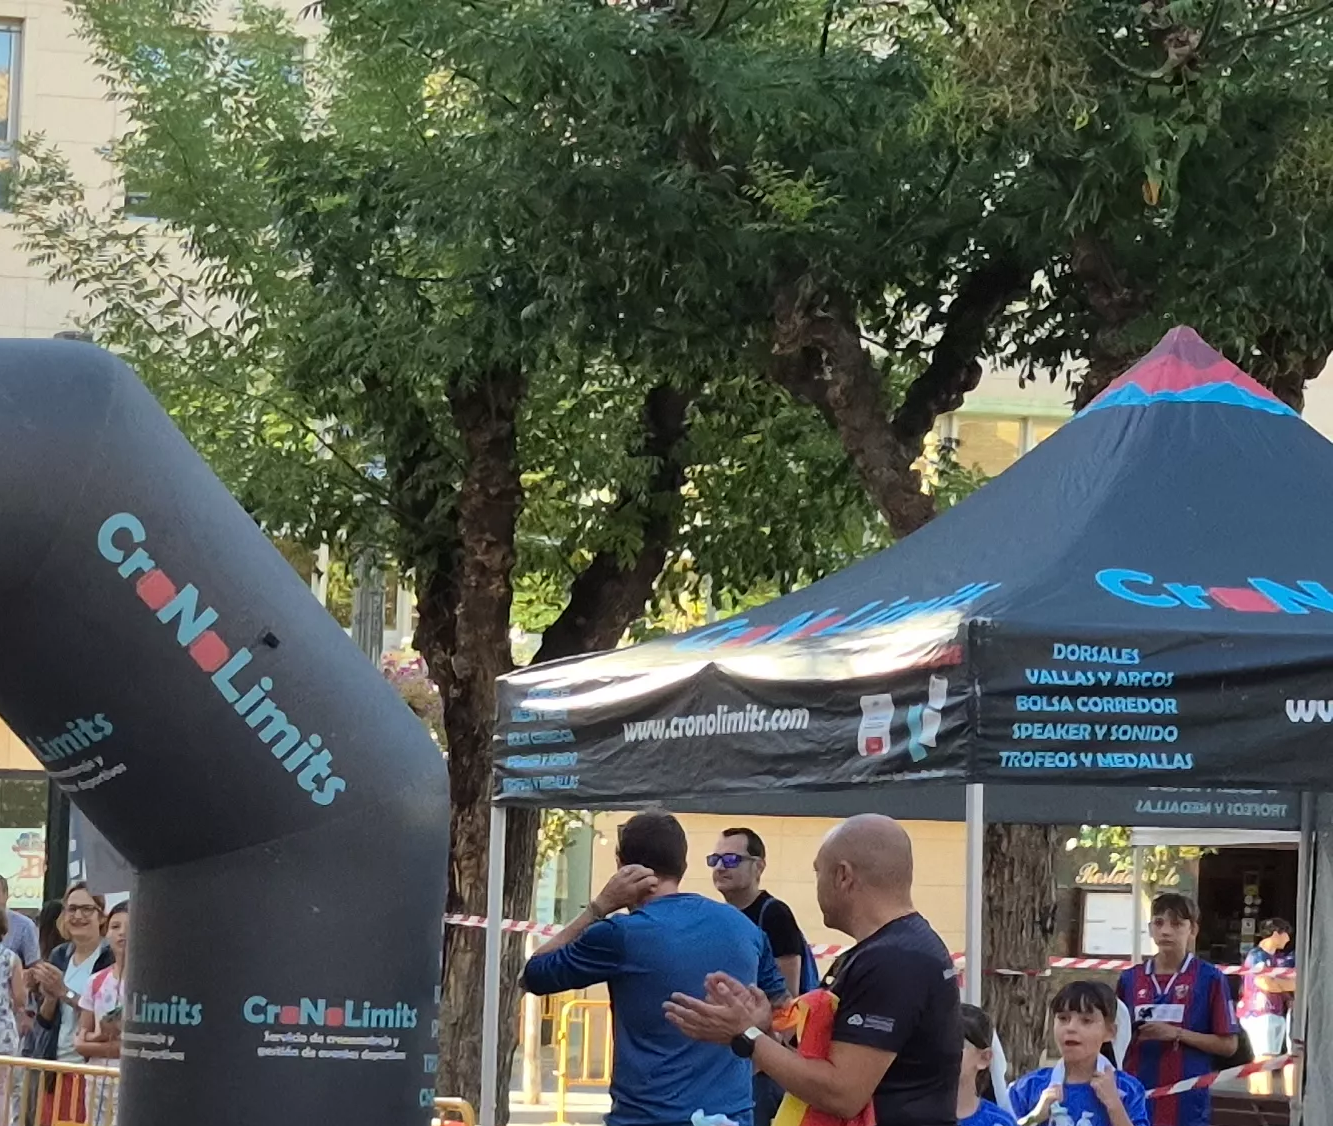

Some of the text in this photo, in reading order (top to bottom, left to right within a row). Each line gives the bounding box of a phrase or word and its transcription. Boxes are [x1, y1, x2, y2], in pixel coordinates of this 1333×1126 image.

[1053, 643, 1140, 664] DORSALES
[1025, 669, 1174, 687] VALLAS Y ARCOS
[1016, 695, 1178, 715] BOLSA CORREDOR
[622, 703, 810, 743] www.cronolimits.com
[1012, 723, 1178, 742] SPEAKER Y SONIDO
[999, 751, 1193, 770] TROFEOS Y MEDALLAS
